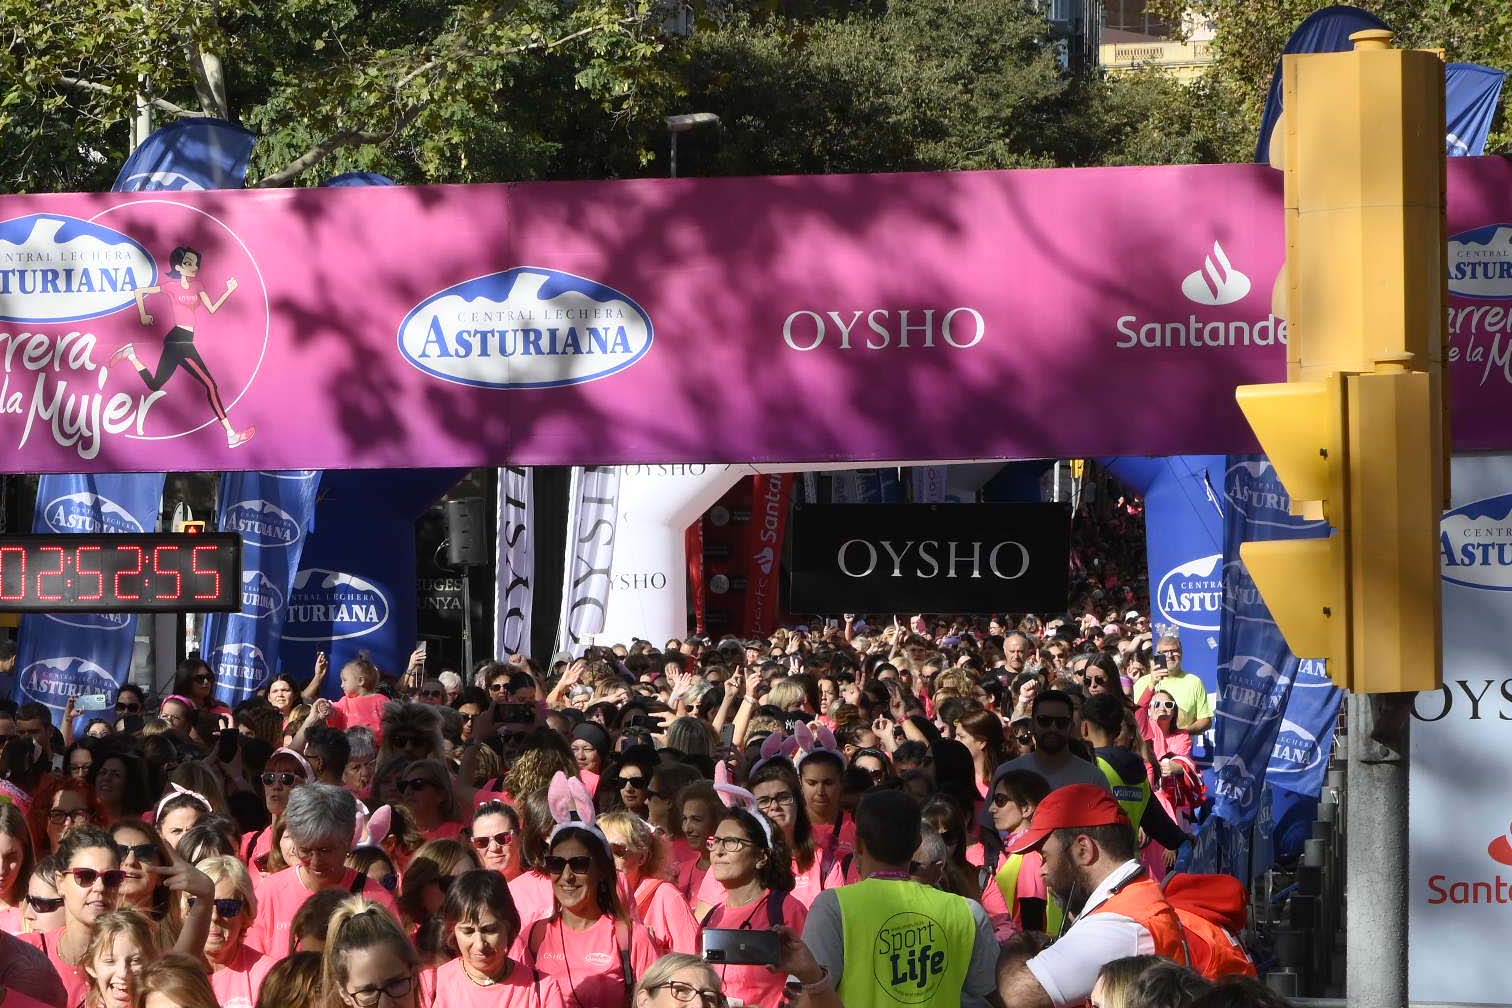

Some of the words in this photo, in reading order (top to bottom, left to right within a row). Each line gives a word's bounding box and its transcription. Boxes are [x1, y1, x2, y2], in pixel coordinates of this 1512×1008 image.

[60, 250, 132, 262] LECHERA
[418, 314, 633, 359] ASTURIANA
[457, 310, 536, 323] CENTRAL
[544, 308, 625, 321] LECHERA
[782, 307, 986, 351] OYSHO
[1465, 336, 1484, 362] la
[1480, 332, 1512, 388] M
[18, 365, 167, 461] Mujer
[838, 539, 1030, 580] OYSHO
[325, 592, 375, 603] LECHERA
[879, 921, 935, 956] Sport
[890, 944, 945, 989] Life
